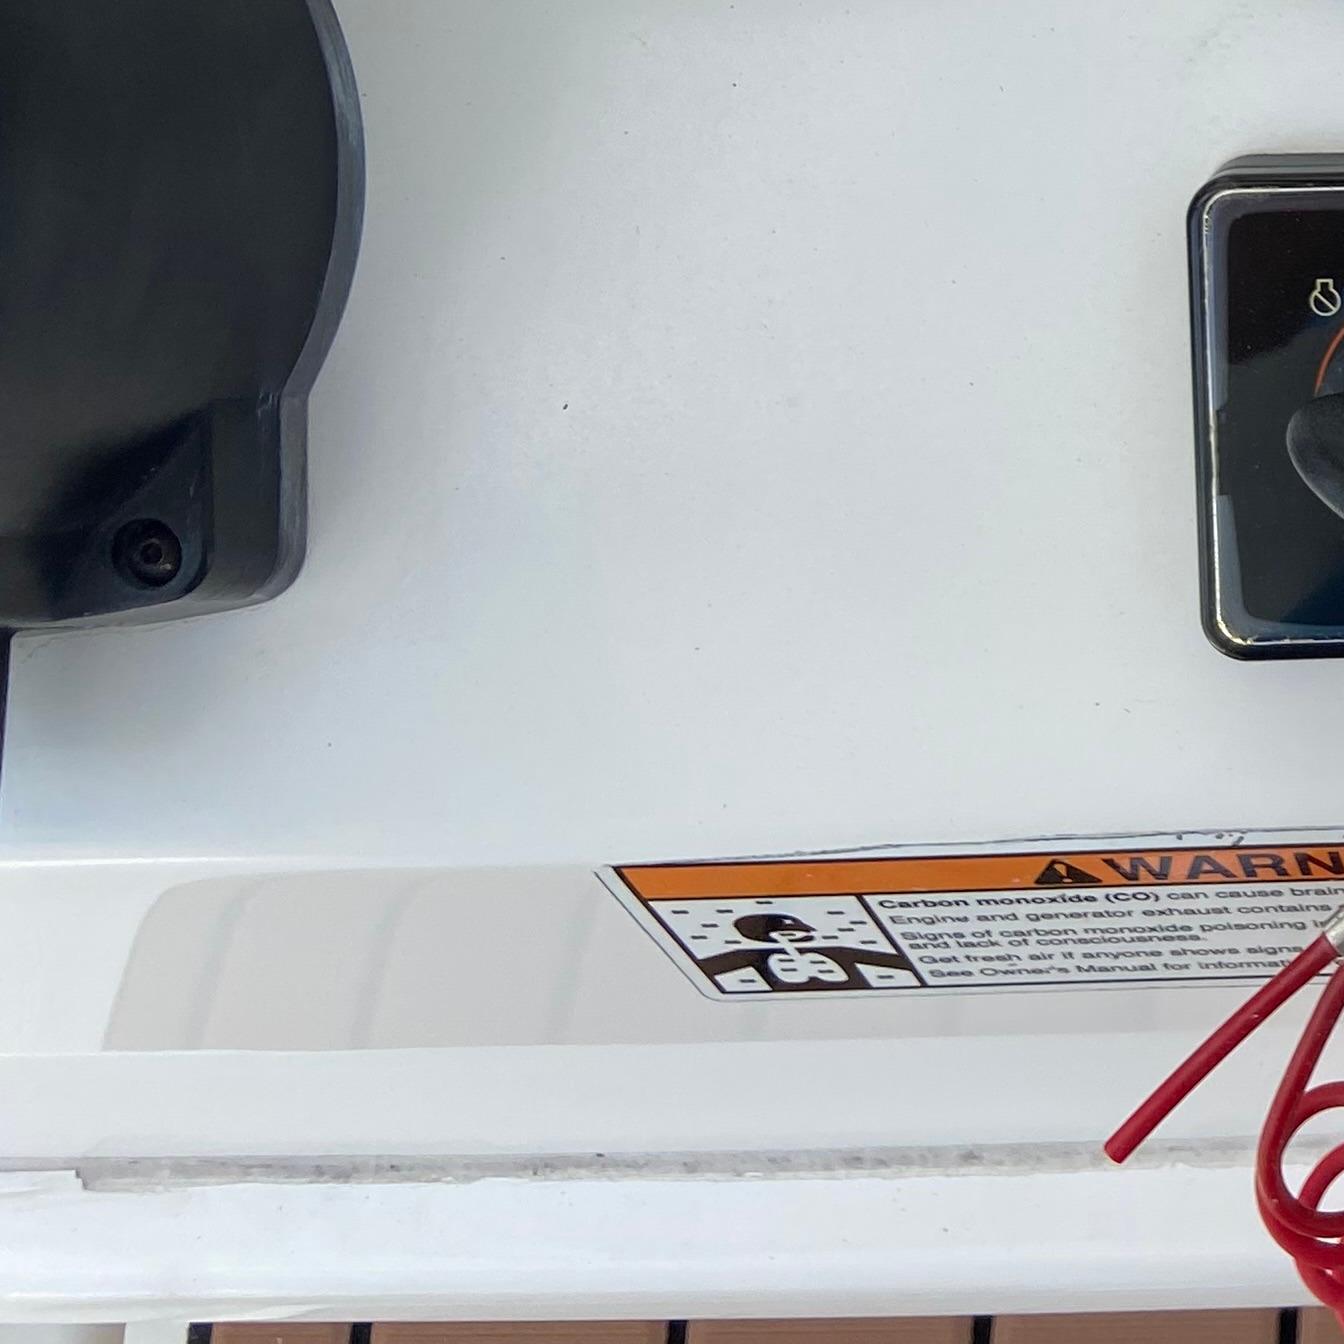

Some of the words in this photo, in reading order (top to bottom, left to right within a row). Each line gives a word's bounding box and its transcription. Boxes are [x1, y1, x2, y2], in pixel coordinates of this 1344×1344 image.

[878, 899, 970, 909] Carbon
[976, 892, 1098, 907] monoxide
[1105, 890, 1160, 904] (CO)
[1166, 889, 1209, 900] can
[1214, 886, 1284, 899] cause
[889, 914, 970, 926] Engine
[976, 912, 1019, 923] and
[1026, 908, 1133, 923] generator
[1142, 906, 1233, 918] exhaust
[1237, 903, 1332, 914] contains
[900, 931, 966, 941] Signs
[971, 929, 993, 939] of
[999, 926, 1077, 938] carbon
[1082, 923, 1193, 935] monoxide
[1200, 920, 1307, 932] poisoning
[908, 939, 950, 950] and
[956, 938, 1002, 949] lack
[1007, 936, 1030, 947] of
[918, 955, 962, 965] Get
[966, 954, 1022, 964] fresh
[1028, 952, 1055, 962] air
[1060, 951, 1075, 960] if
[1080, 949, 1164, 961] anyone
[1169, 946, 1240, 957] shows
[928, 969, 974, 979] See
[979, 966, 1071, 977] Owner's
[1074, 963, 1157, 975] Manual
[1161, 962, 1192, 971] for
